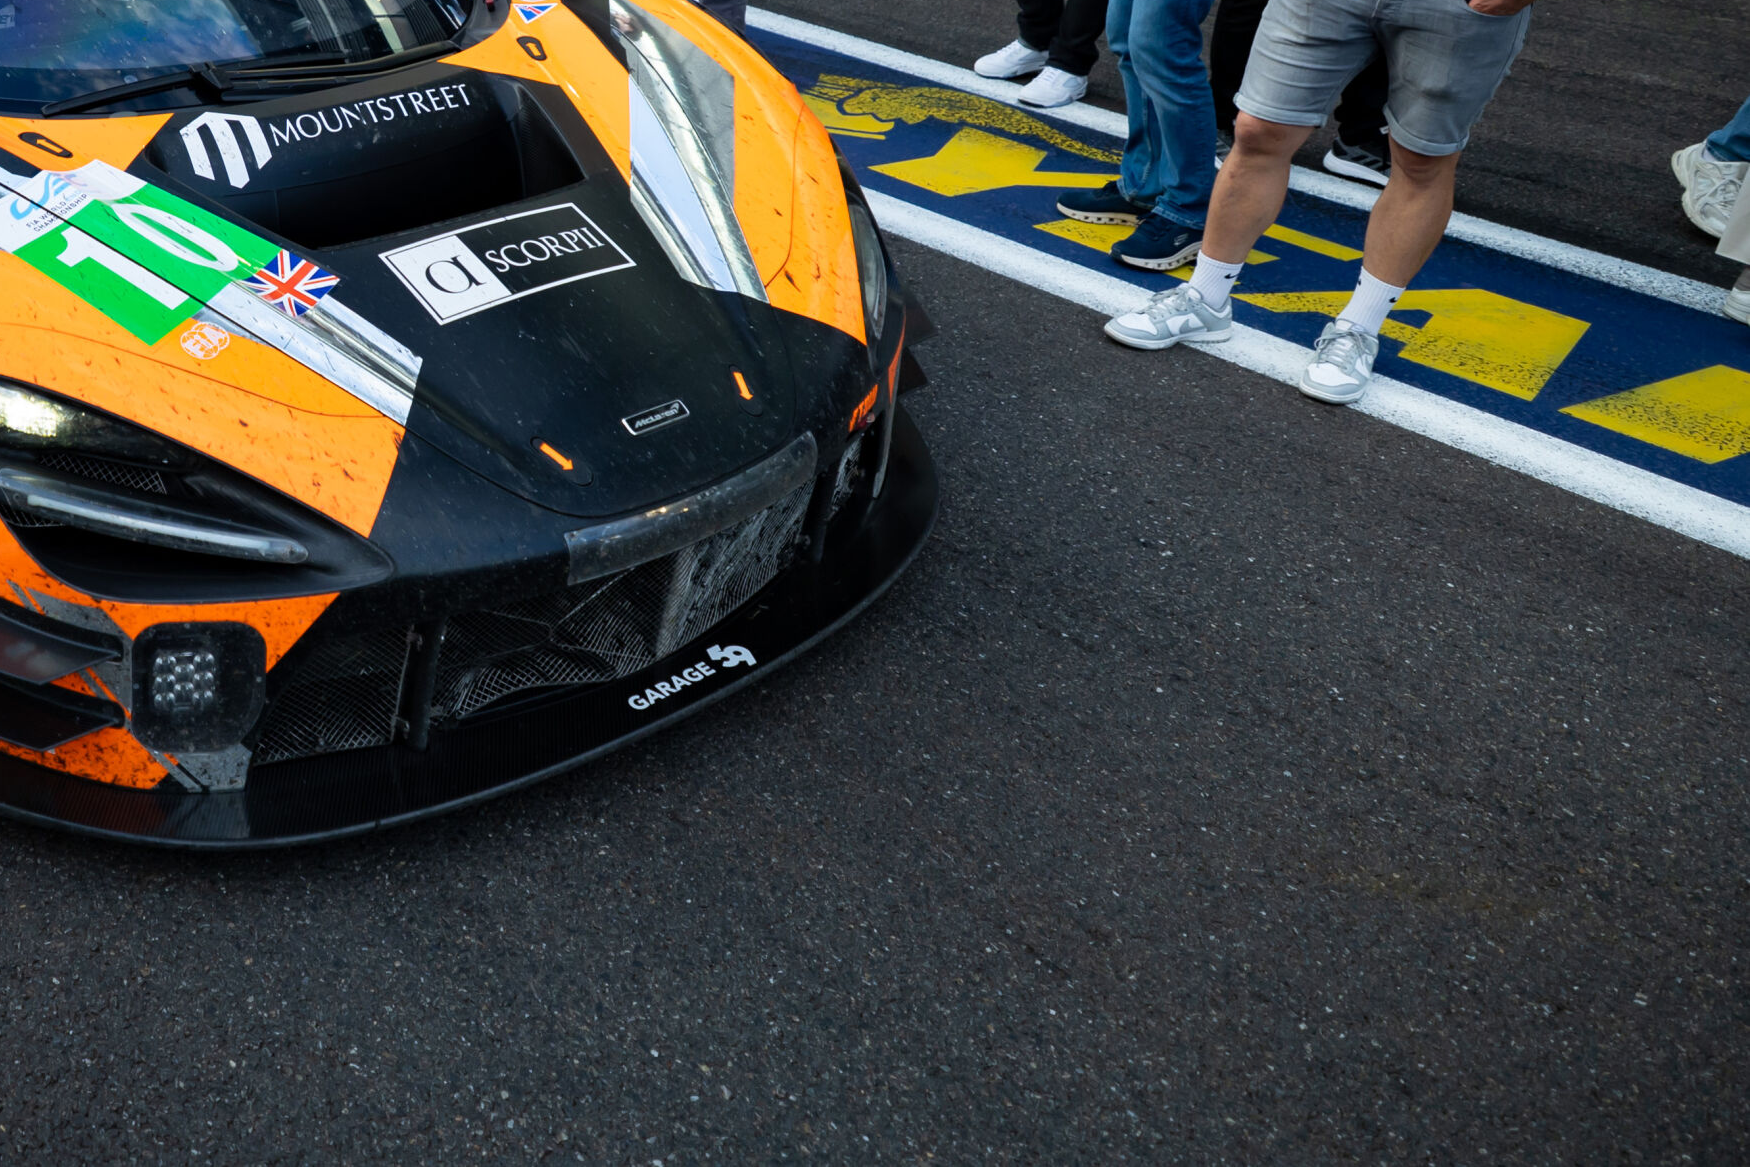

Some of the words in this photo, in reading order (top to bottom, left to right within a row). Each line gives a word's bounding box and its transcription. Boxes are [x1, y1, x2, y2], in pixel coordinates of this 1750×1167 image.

[269, 83, 472, 147] MOUNTSTREET
[56, 203, 239, 310] 10
[485, 226, 605, 273] SCORPII
[182, 324, 228, 358] FIA
[635, 403, 680, 428] McLaren
[628, 661, 716, 710] GARAGE
[706, 644, 757, 667] 59
